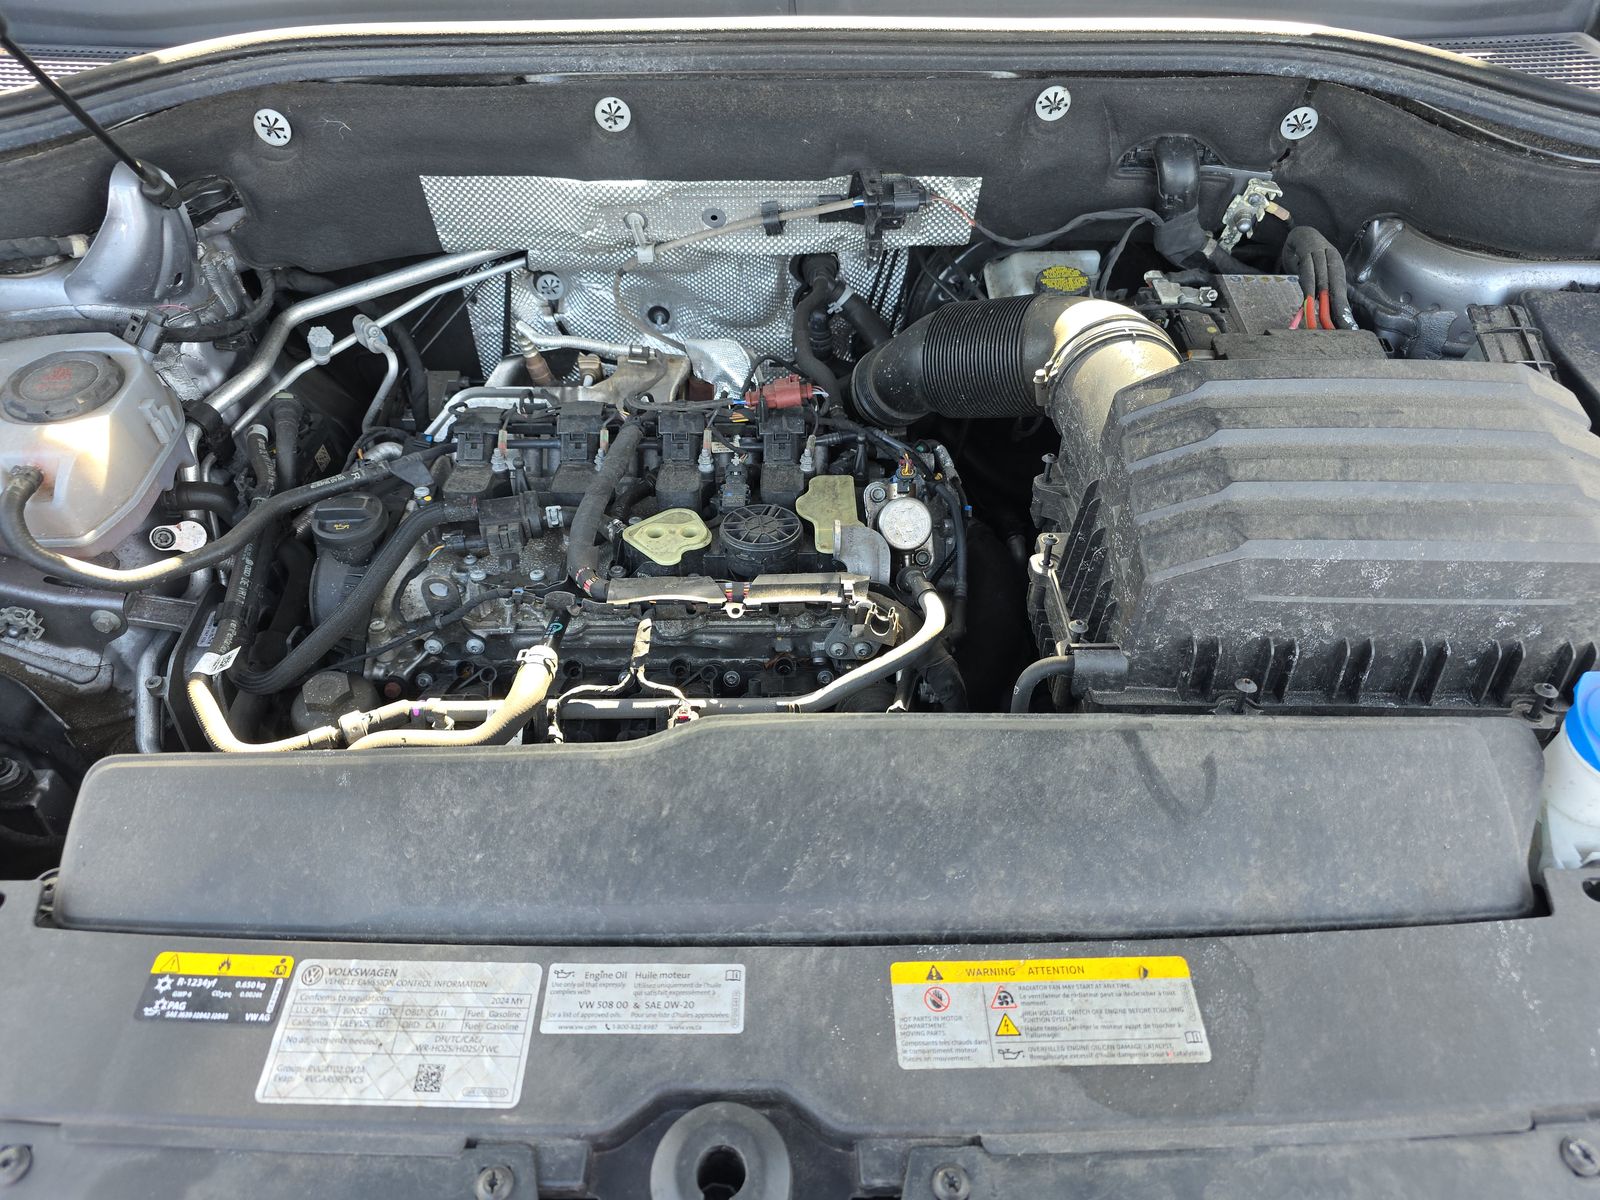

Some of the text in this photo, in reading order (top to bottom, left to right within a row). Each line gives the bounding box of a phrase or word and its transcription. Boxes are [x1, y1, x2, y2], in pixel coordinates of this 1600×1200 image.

[327, 967, 399, 977] VOLKSWAGEN
[965, 965, 1085, 977] WARNING ATTENTION
[585, 970, 691, 982] Engine Oil Huile moteur
[177, 977, 218, 989] R-1234yf
[256, 981, 266, 991] kg
[324, 978, 489, 988] VEHICLE EMISSION CONTROL INFORMATION
[599, 982, 626, 990] expressly
[656, 983, 694, 991] uniquement
[299, 993, 336, 1001] Conforms
[338, 994, 347, 1002] to
[168, 1001, 187, 1010] PAG
[578, 1001, 595, 1009] VW
[597, 1001, 614, 1009] 508
[616, 1001, 629, 1009] 00
[644, 1001, 662, 1009] SAE
[664, 1001, 696, 1009] 0W-20
[245, 1013, 260, 1022] VW
[260, 1013, 271, 1022] AG
[488, 1010, 523, 1018] Gasoline
[486, 1022, 519, 1030] Gasoline
[298, 1036, 347, 1046] adjustments
